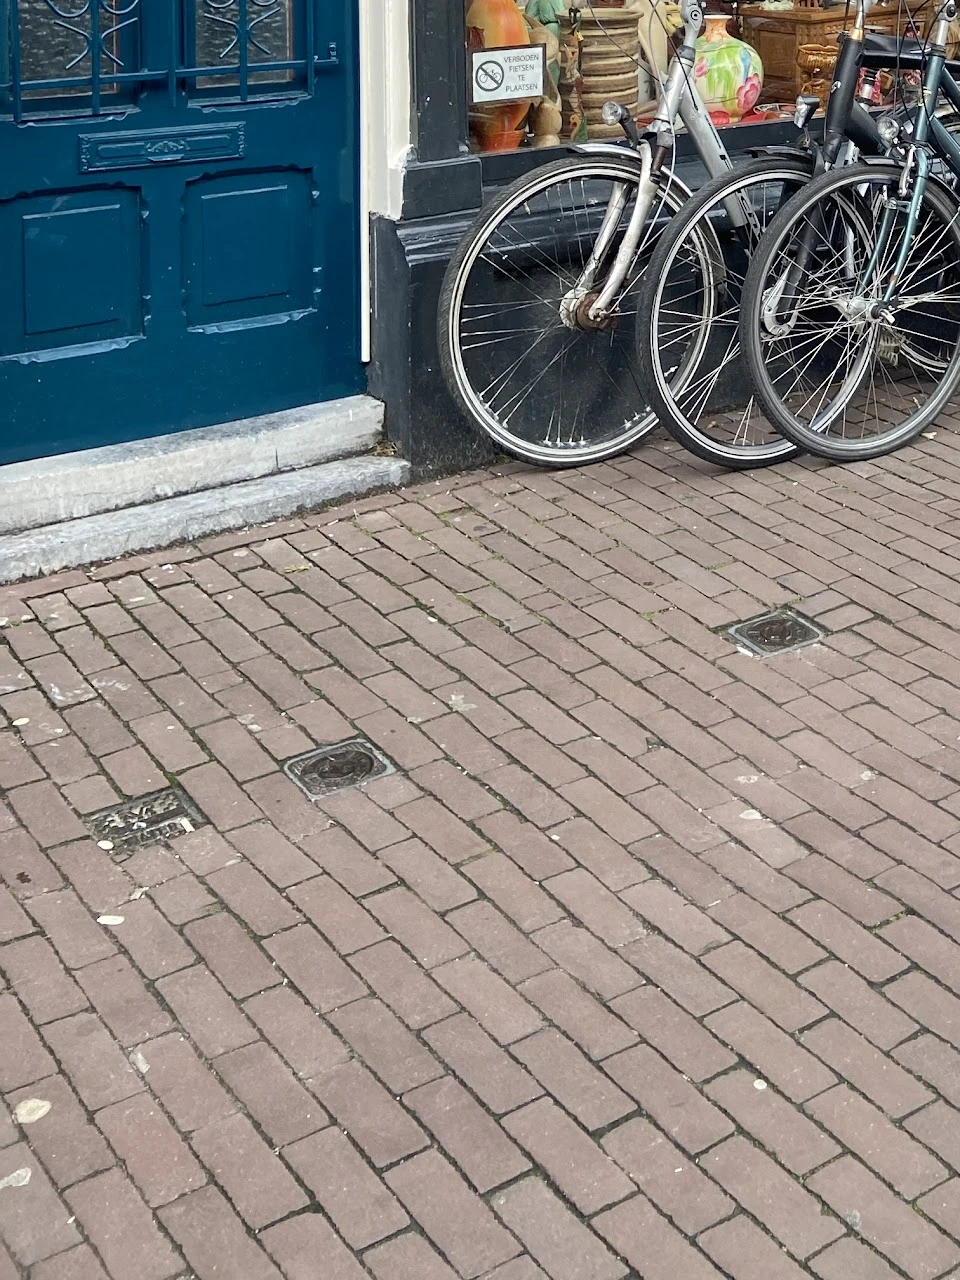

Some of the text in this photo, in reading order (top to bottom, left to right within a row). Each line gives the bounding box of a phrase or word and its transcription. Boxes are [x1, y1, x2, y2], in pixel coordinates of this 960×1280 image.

[503, 54, 539, 63] VERBODEN
[509, 64, 535, 72] FIETSEN
[505, 83, 538, 92] PLAATSEN
